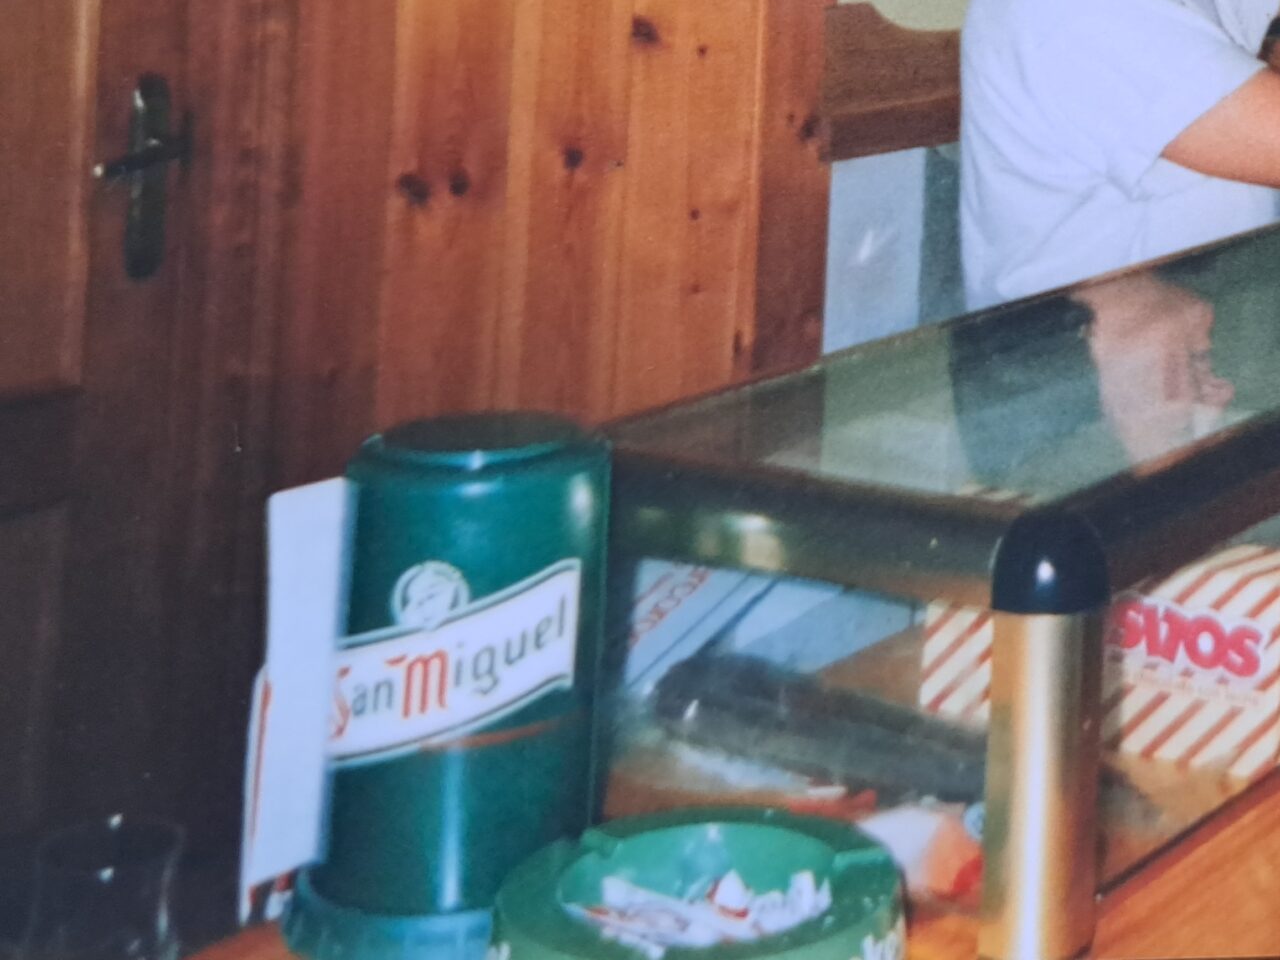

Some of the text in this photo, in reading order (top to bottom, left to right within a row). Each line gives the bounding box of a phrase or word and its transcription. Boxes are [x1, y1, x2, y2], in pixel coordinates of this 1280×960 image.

[332, 665, 395, 741] San
[384, 595, 567, 719] Miguel
[1112, 599, 1262, 678] SITOS
